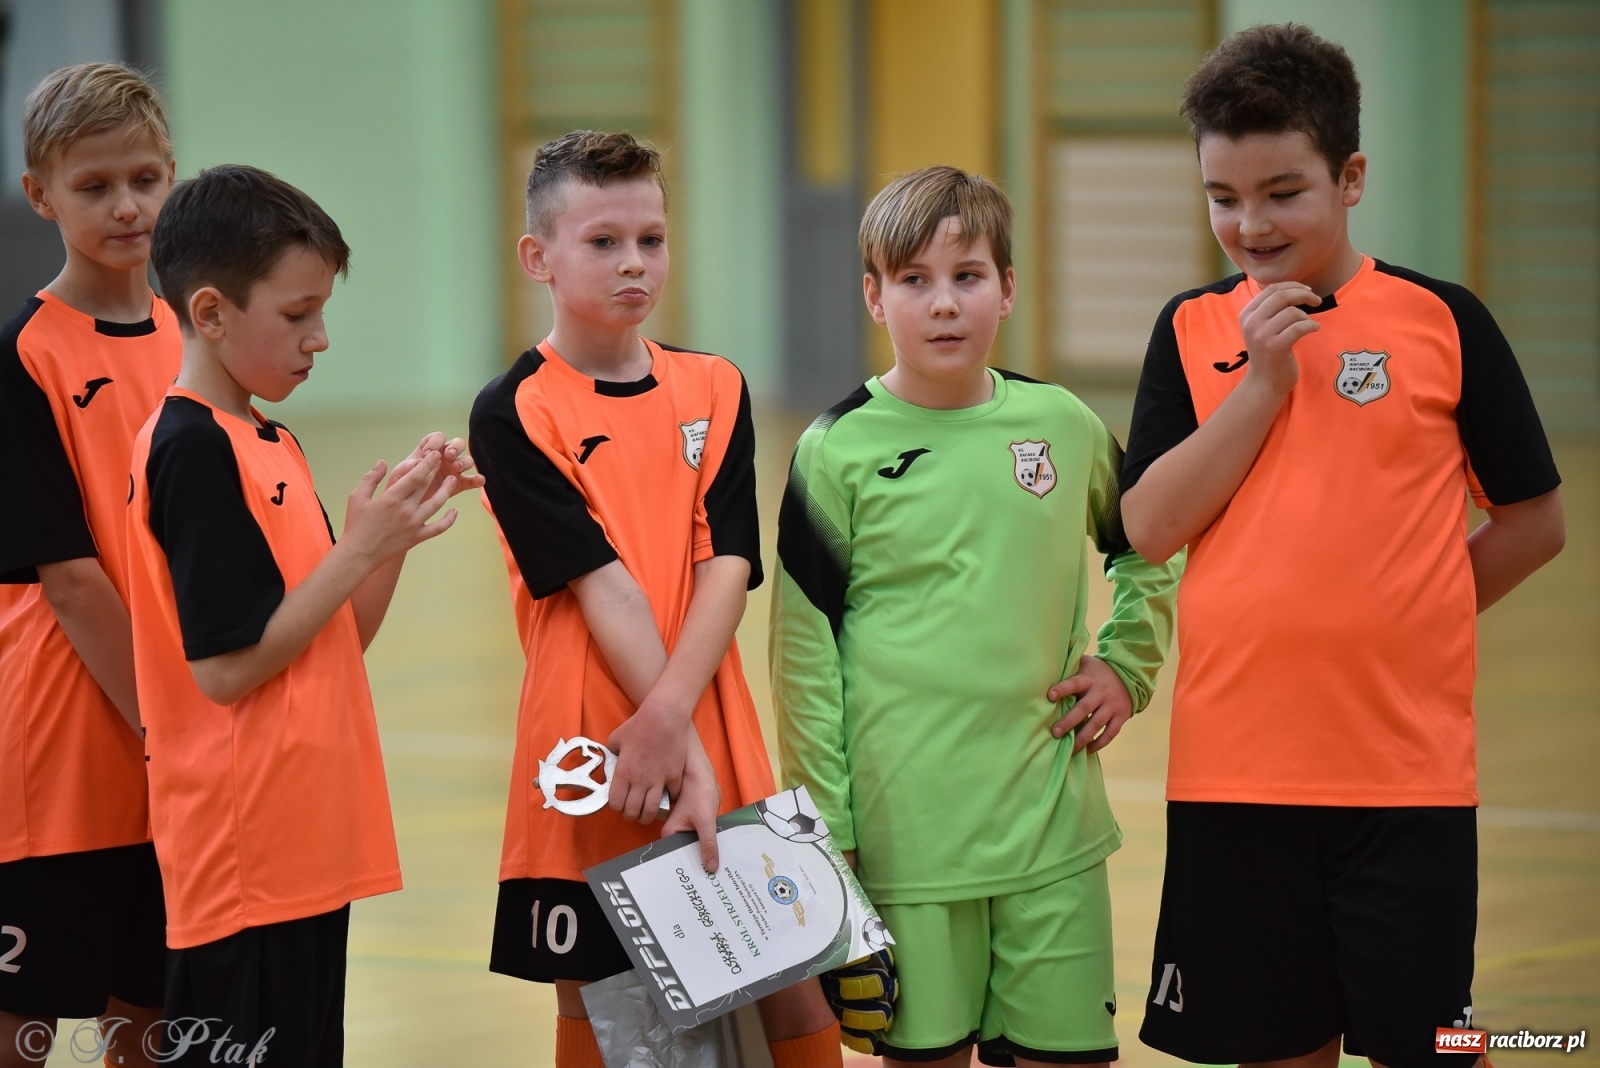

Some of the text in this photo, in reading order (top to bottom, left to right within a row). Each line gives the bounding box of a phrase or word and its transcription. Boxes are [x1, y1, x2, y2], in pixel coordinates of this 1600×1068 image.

[1366, 382, 1385, 390] 1951
[1039, 473, 1053, 481] 1951
[531, 899, 578, 954] 10
[671, 923, 685, 940] dla
[700, 863, 761, 958] KRÓL STRZELCÓ
[601, 880, 692, 1012] DYPLOM
[709, 931, 743, 976] OSKARA
